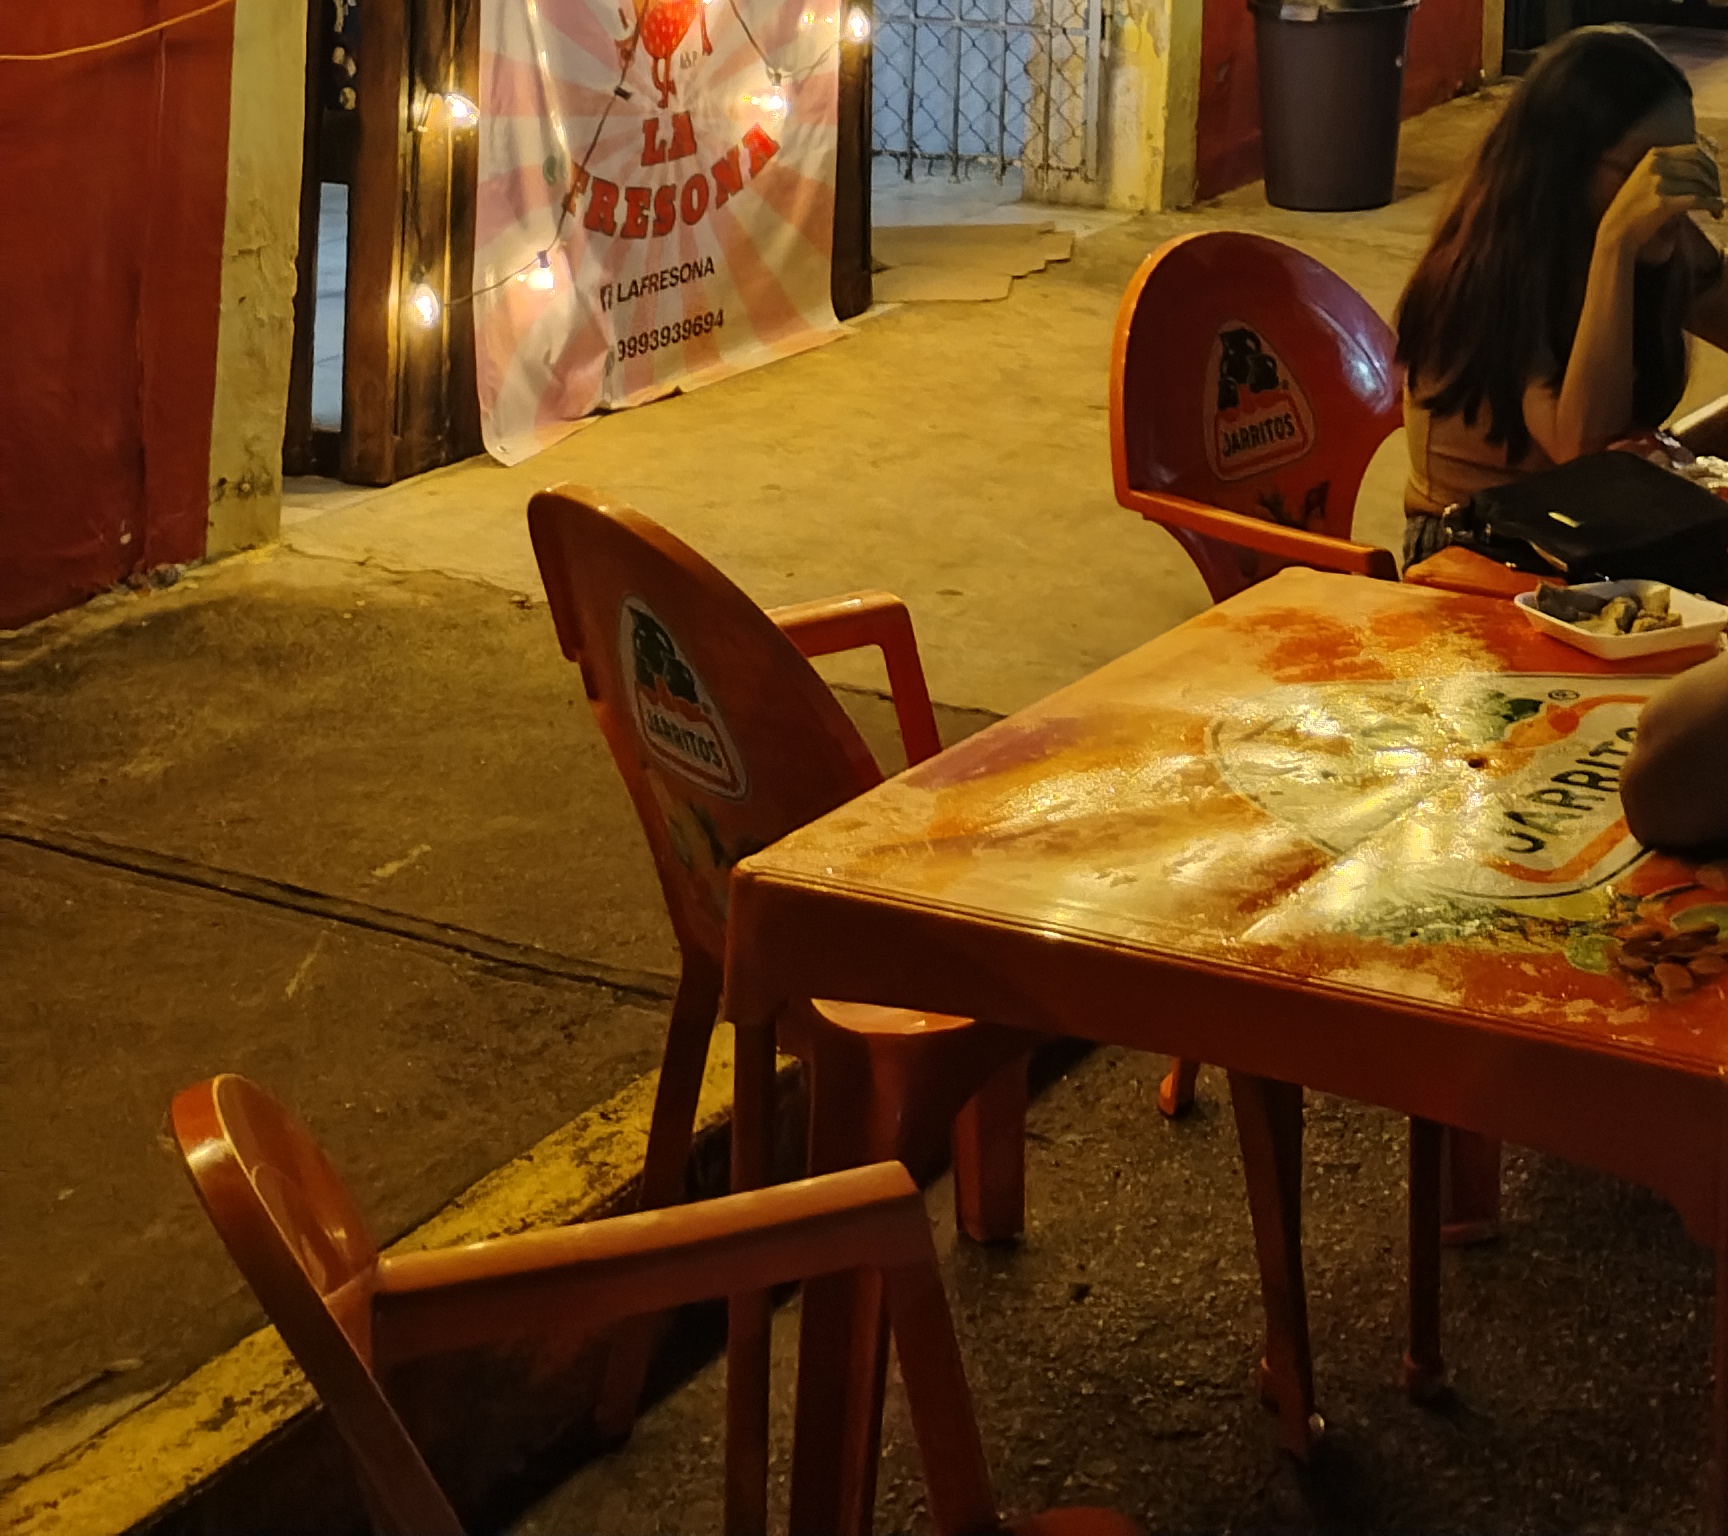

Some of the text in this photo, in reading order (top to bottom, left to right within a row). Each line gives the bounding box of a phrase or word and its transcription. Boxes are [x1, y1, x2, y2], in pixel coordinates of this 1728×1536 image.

[641, 110, 697, 166] LA
[564, 122, 780, 239] FRESONA
[617, 256, 715, 303] LAFRESONA
[1222, 413, 1296, 458] JARRITOS
